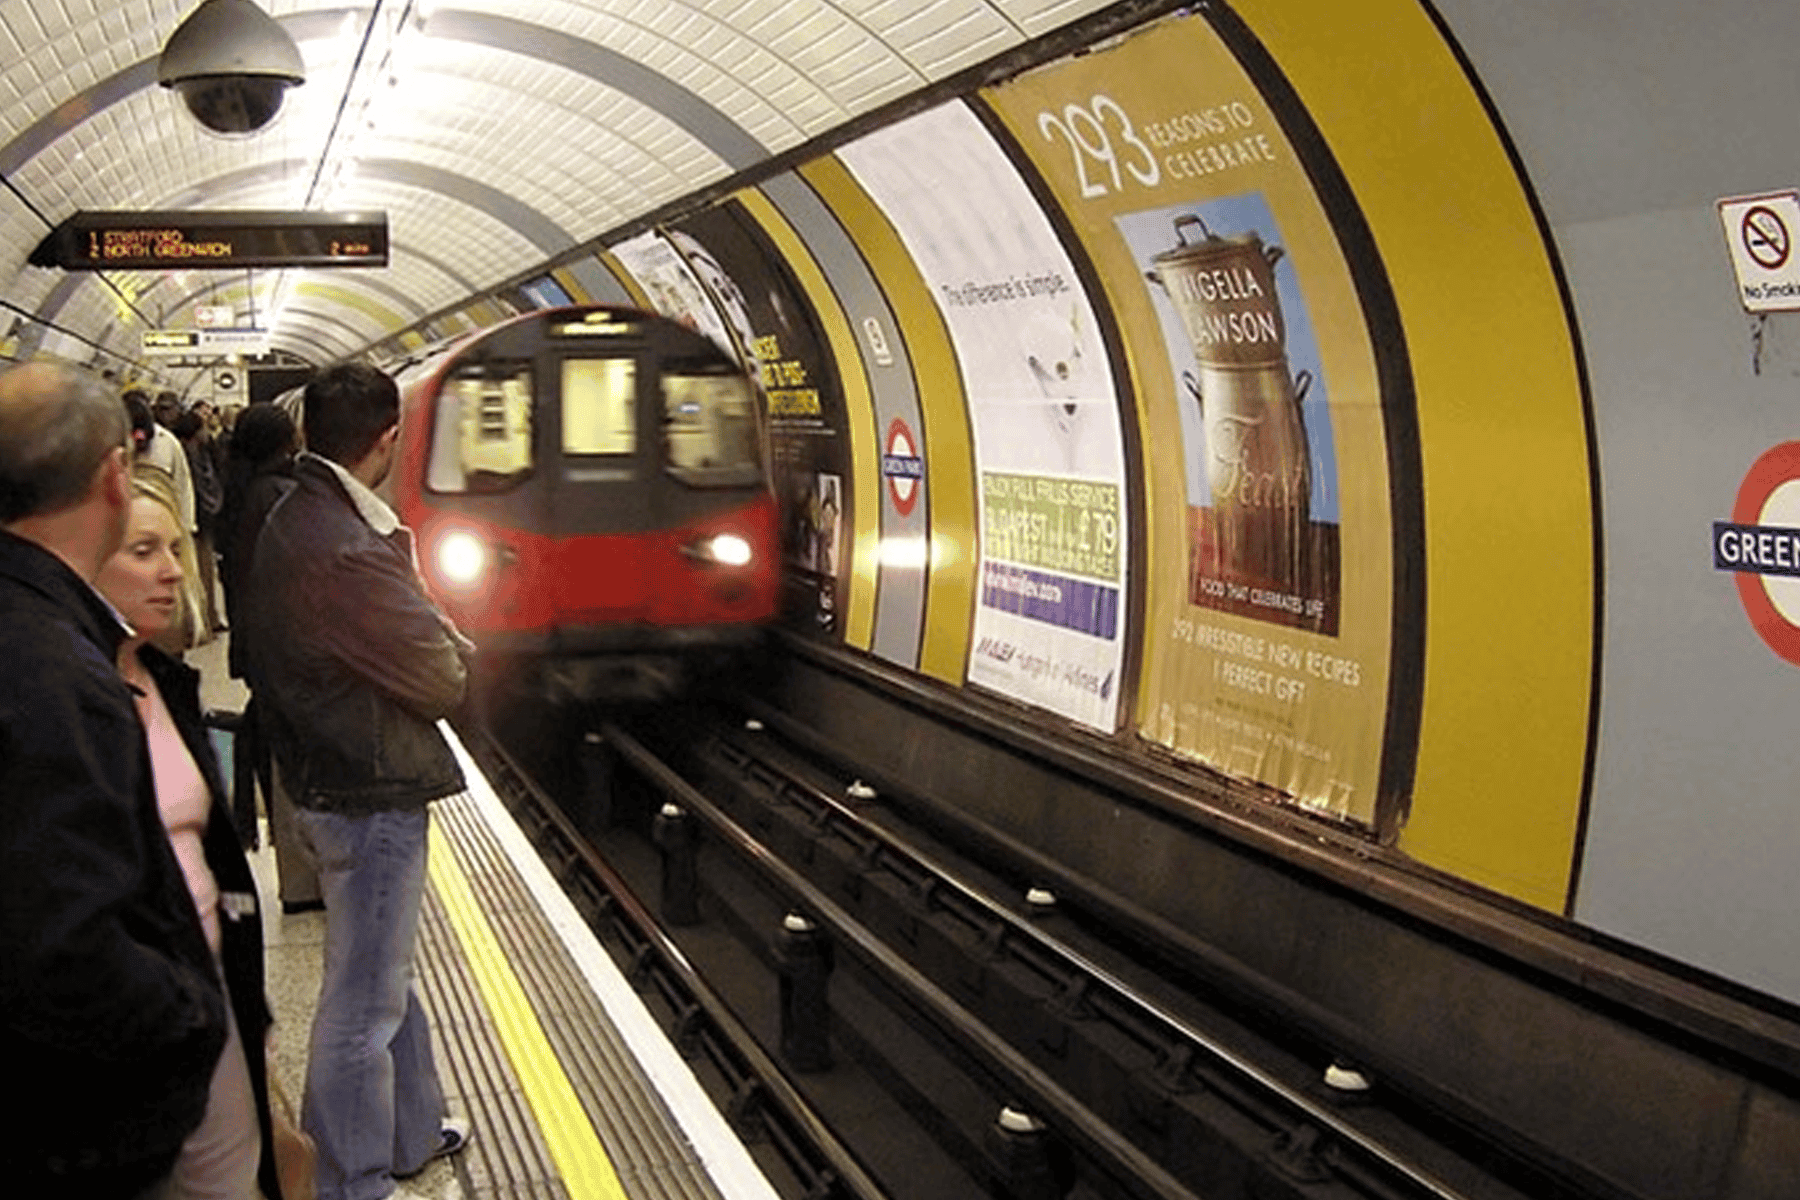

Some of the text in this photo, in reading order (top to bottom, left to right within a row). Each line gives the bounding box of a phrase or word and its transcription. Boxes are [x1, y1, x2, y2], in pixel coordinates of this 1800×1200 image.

[1038, 94, 1253, 199] 293 REASONS TO
[1164, 133, 1277, 180] CELEBRATE
[90, 231, 97, 245] 1
[90, 244, 99, 258] 2
[103, 243, 149, 258] NORTH
[331, 241, 340, 256] 2
[1181, 267, 1263, 302] NIGELLA
[1744, 285, 1762, 300] No
[1190, 312, 1278, 344] LAWSON
[1200, 578, 1225, 598] FOOD
[1196, 623, 1265, 662] IRRESISTIBLE
[1268, 642, 1303, 671] NEW
[1305, 650, 1361, 687] RECIPES
[1223, 661, 1274, 695] PERFECT
[1275, 676, 1305, 704] GIFT
